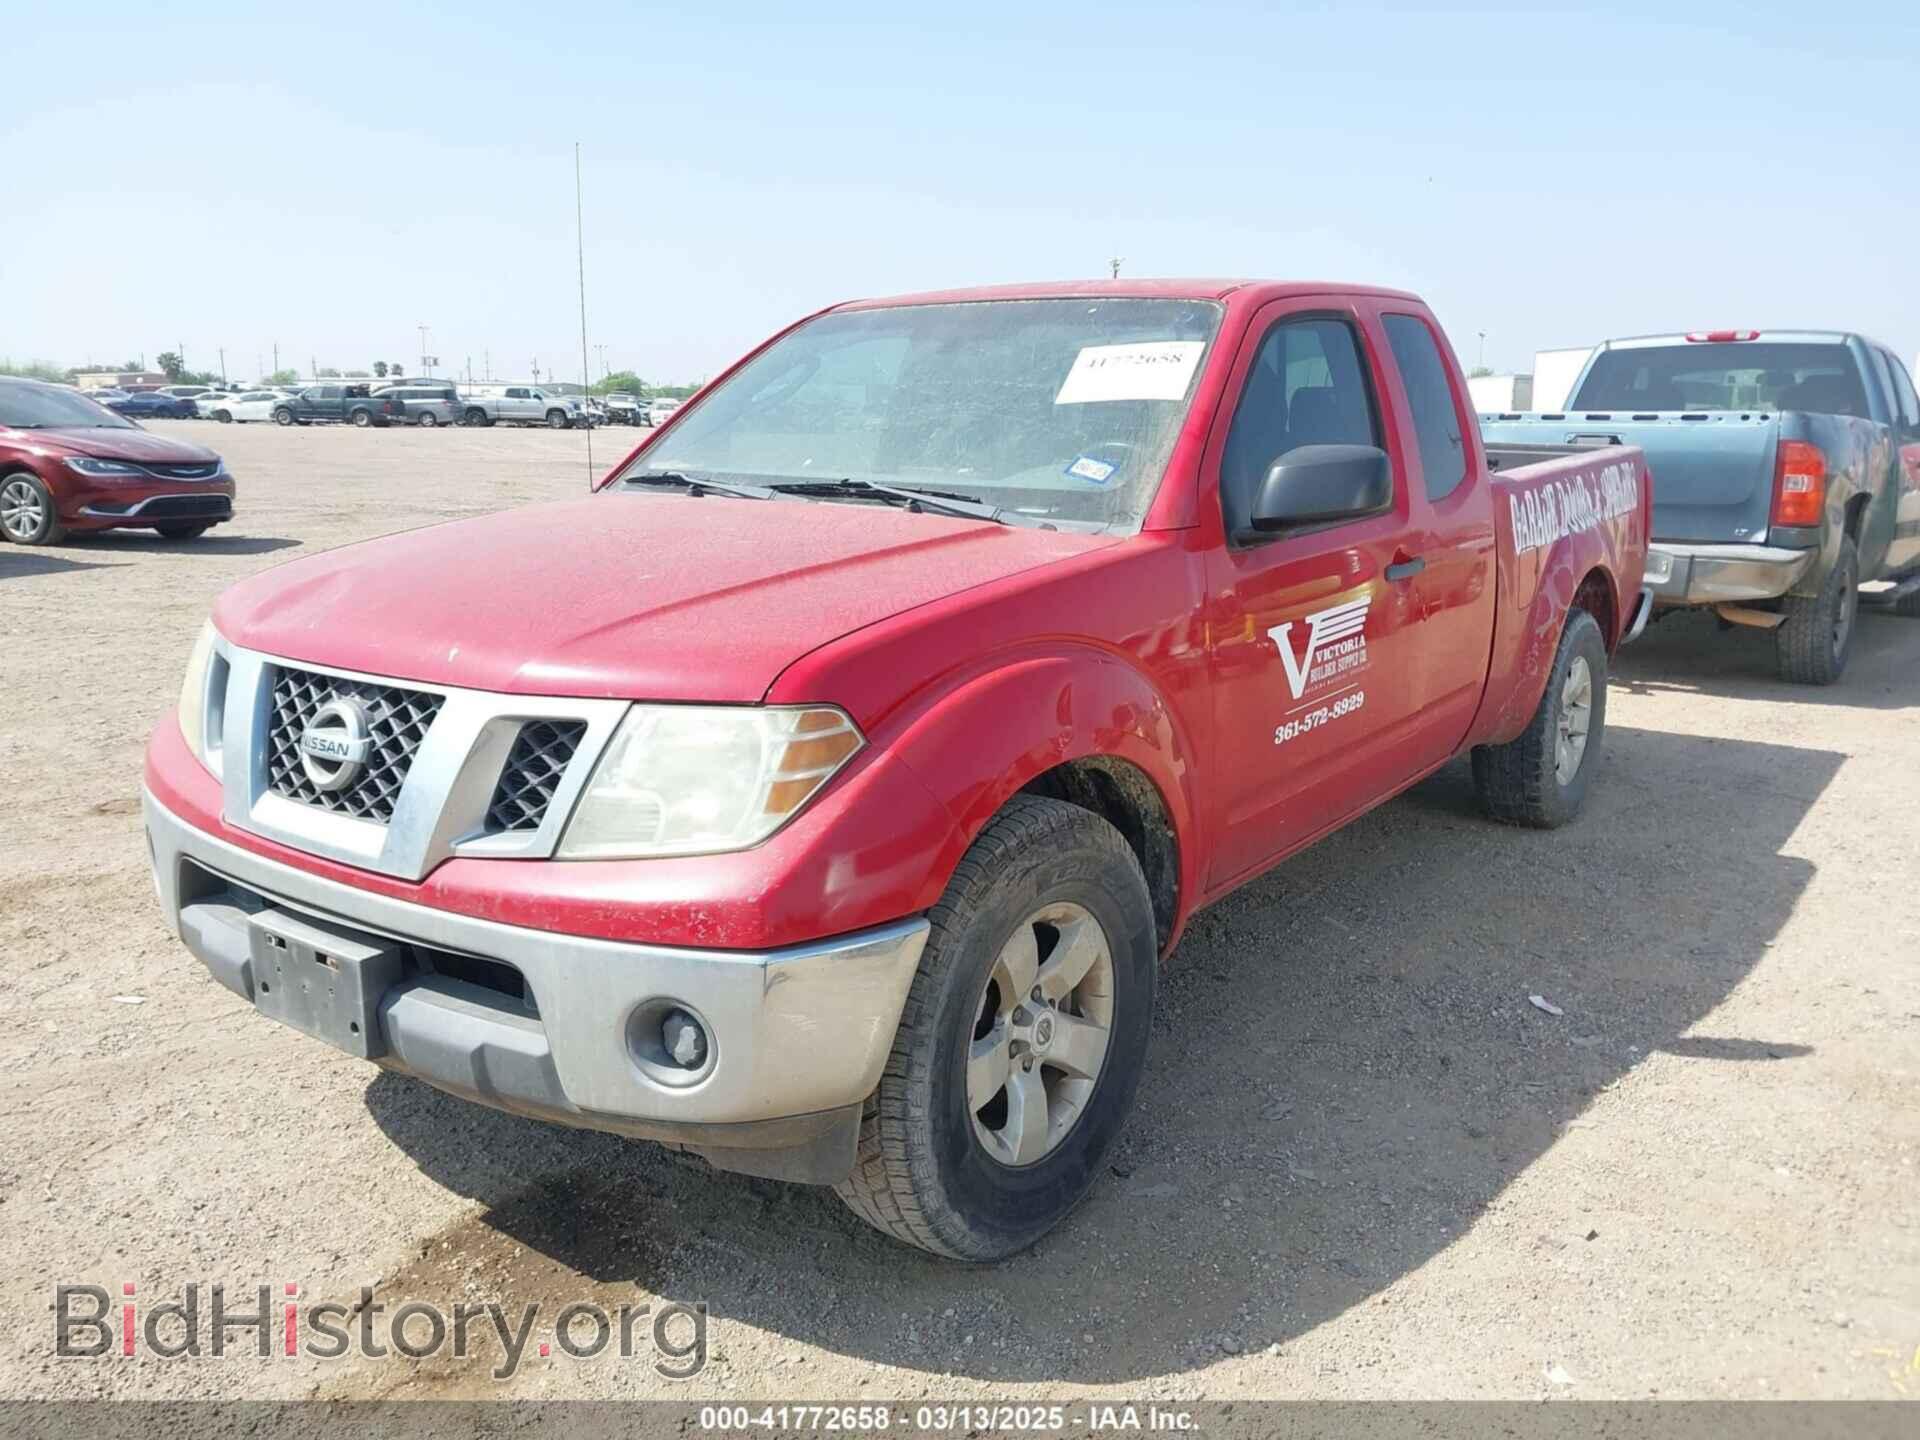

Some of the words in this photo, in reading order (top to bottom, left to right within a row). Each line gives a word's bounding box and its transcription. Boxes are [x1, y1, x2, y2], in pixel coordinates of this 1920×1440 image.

[1315, 634, 1366, 664] VICTORIA
[1274, 691, 1365, 745] 361-572-8929
[302, 734, 350, 756] NISSAN
